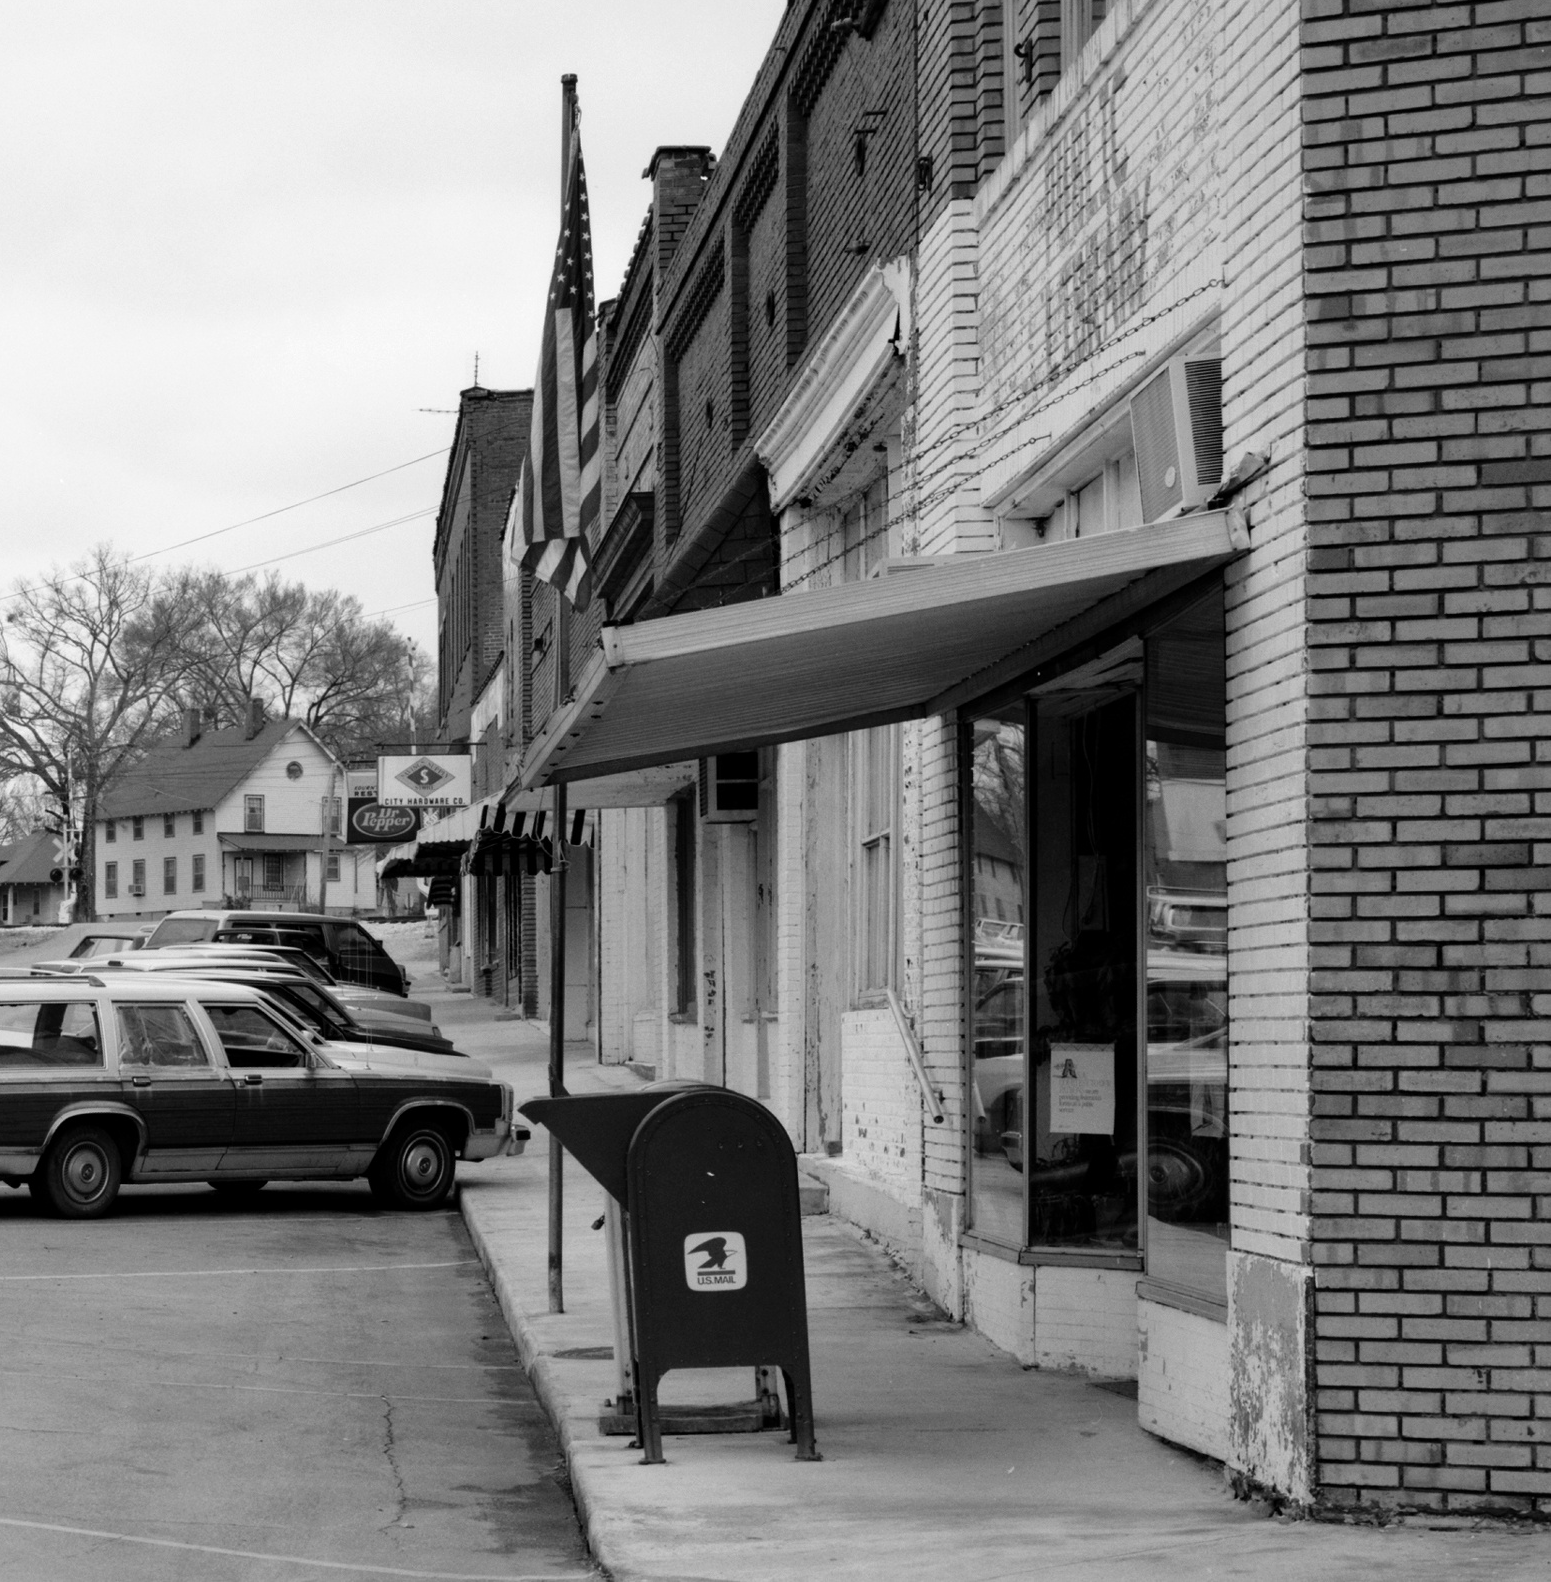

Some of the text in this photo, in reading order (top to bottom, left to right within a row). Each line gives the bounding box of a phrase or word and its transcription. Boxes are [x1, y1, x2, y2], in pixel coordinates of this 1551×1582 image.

[420, 768, 430, 784] S
[384, 797, 466, 806] CITY HARDWARE CO.
[379, 807, 400, 818] Dr
[361, 811, 411, 832] Pepper
